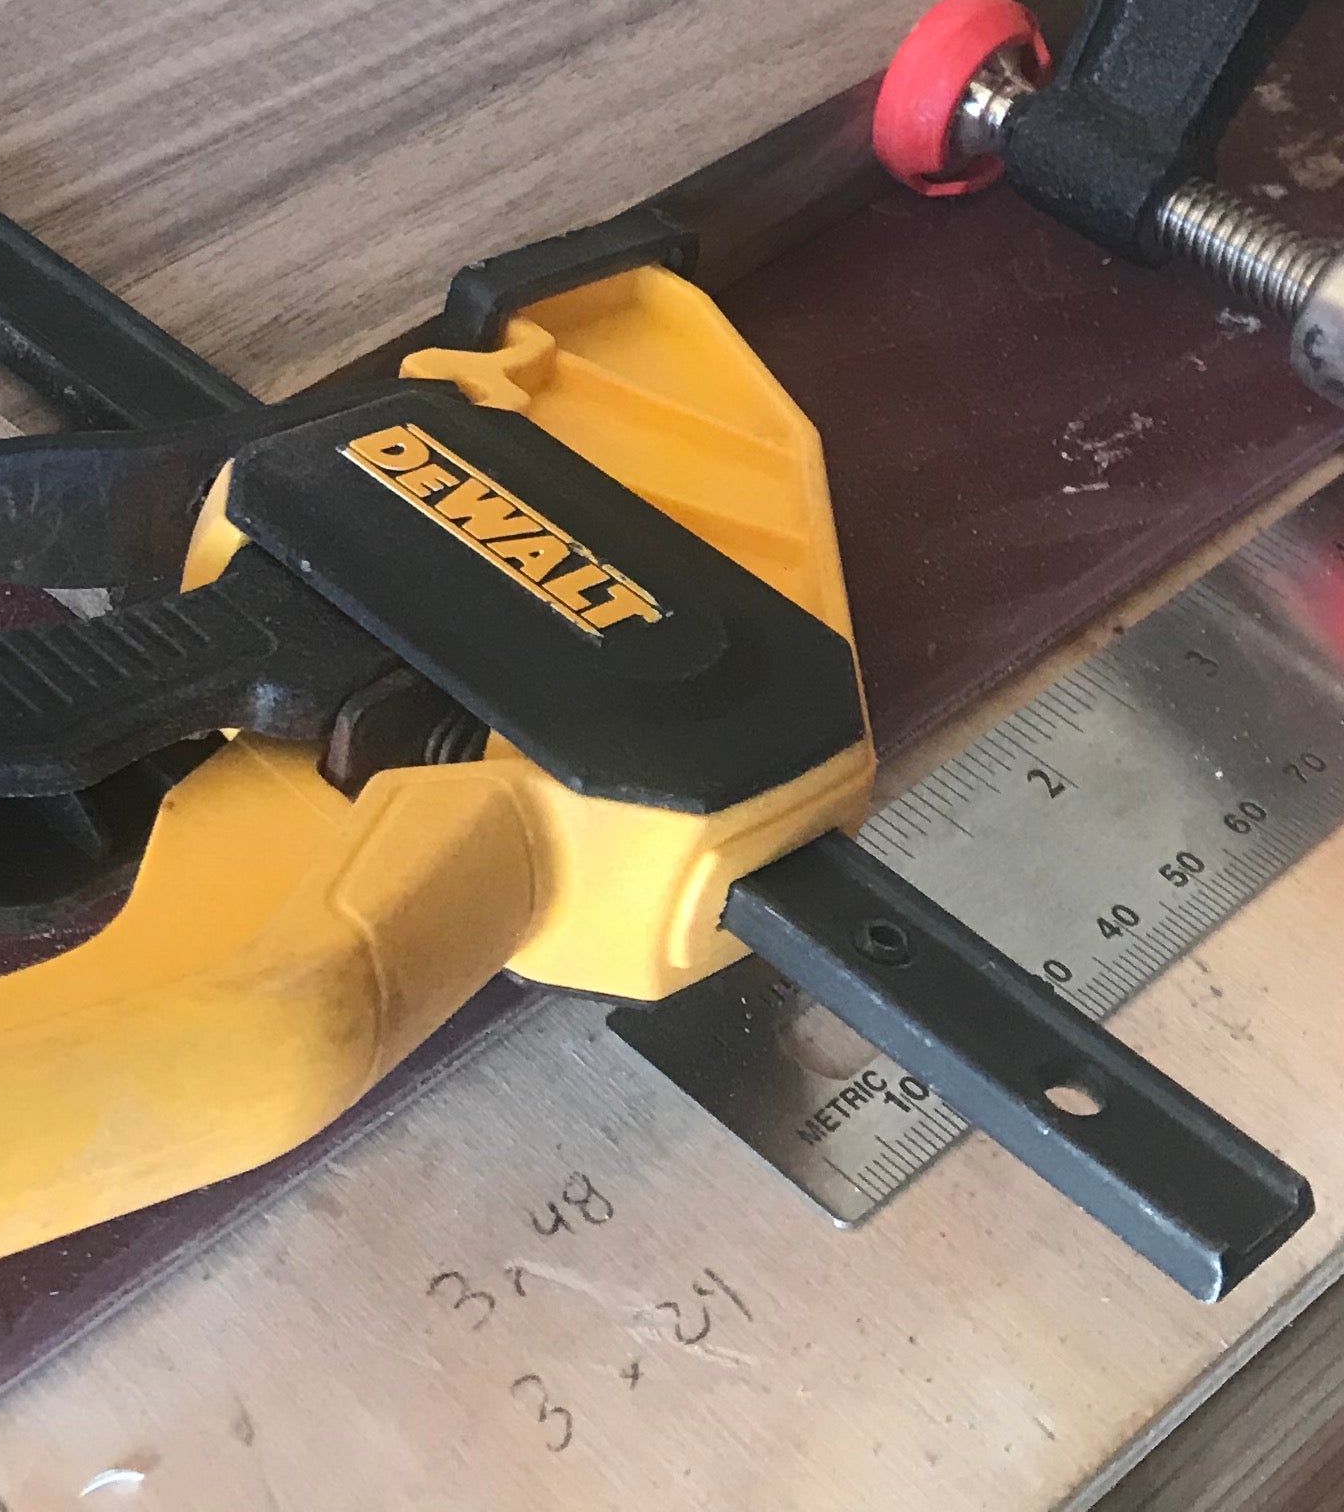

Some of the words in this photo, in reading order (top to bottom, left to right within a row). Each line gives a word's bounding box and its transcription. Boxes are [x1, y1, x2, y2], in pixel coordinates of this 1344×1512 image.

[346, 424, 662, 629] DEWALT
[1027, 769, 1065, 799] 2
[1185, 650, 1219, 678] 3
[883, 1075, 930, 1113] 10
[1096, 904, 1140, 939] 40
[1159, 850, 1205, 887] 50
[1223, 801, 1267, 835] 60
[1282, 753, 1327, 784] 70
[796, 1070, 887, 1146] METRIC
[426, 1271, 496, 1331] 3
[511, 1372, 574, 1453] 3
